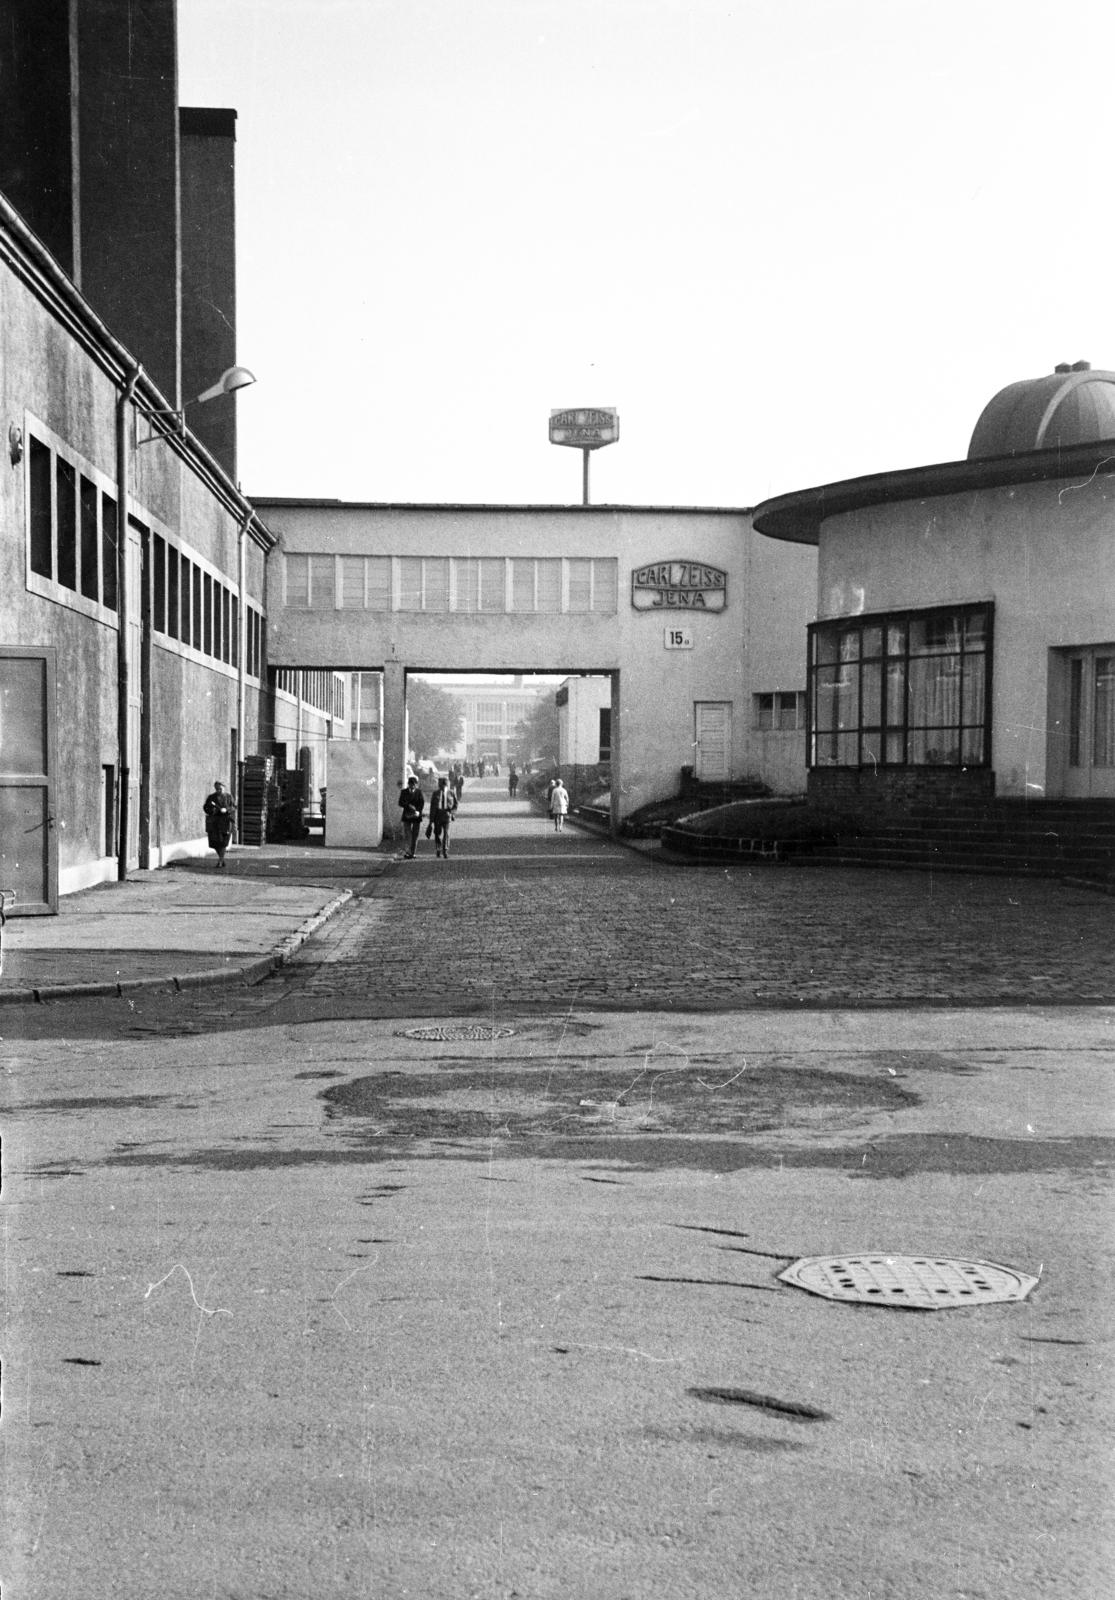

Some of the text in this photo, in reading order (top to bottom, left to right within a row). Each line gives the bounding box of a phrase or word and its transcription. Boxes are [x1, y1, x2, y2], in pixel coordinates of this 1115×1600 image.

[637, 563, 722, 588] CARL ZEISS
[652, 591, 706, 607] JENA
